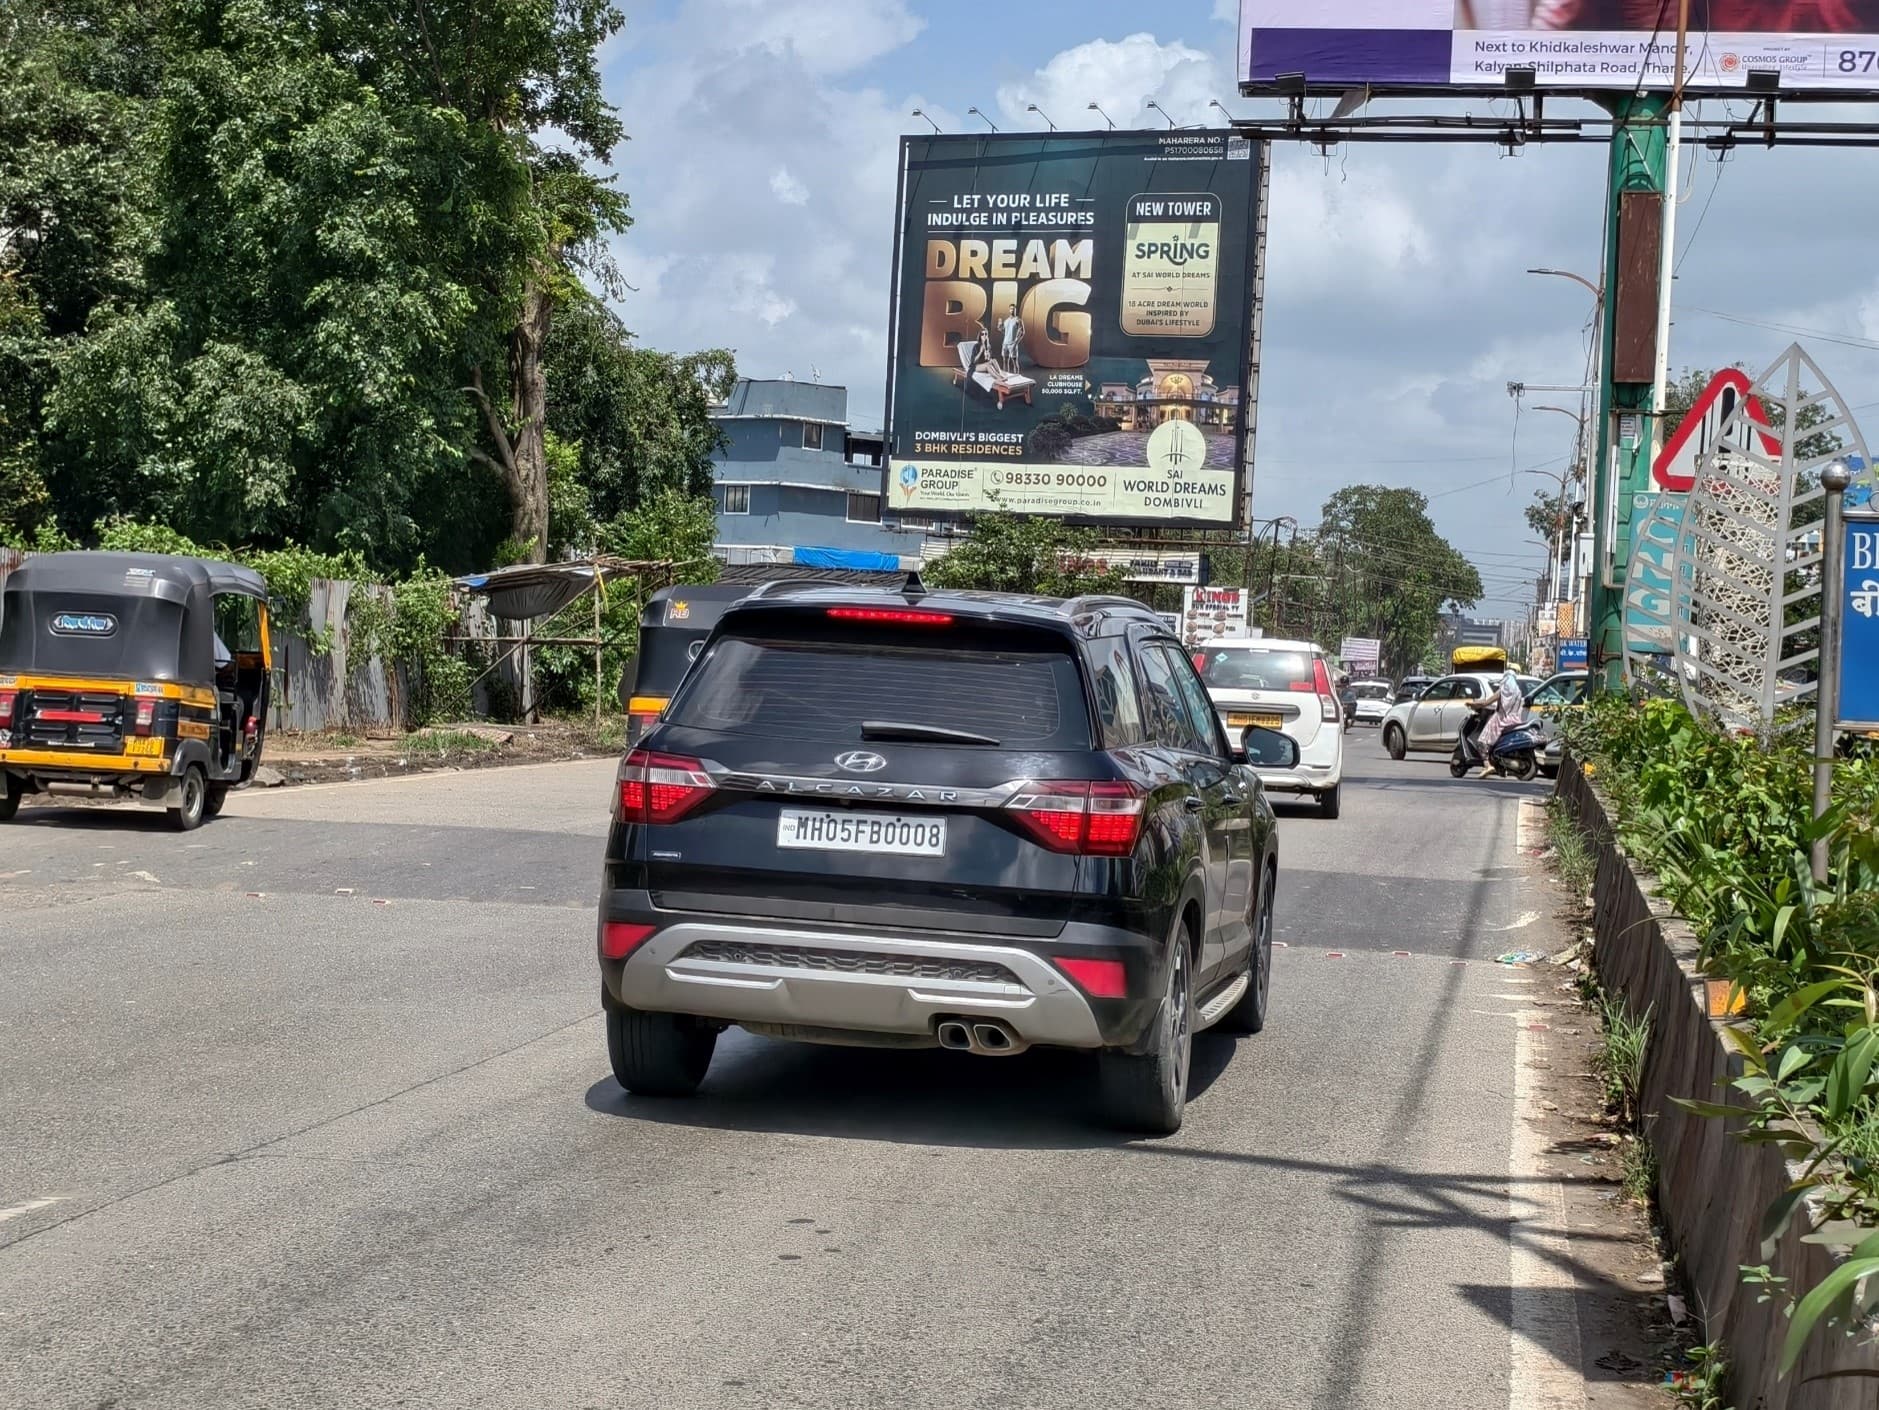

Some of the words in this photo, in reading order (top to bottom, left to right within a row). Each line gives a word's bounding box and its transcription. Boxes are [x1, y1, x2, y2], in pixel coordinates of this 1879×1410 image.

[1475, 41, 1507, 53] Next
[1511, 41, 1525, 53] to
[1529, 41, 1636, 54] Khidkaleshwar
[1639, 43, 1693, 56] Manr,
[1741, 55, 1777, 63] COSMOS
[1600, 62, 1641, 75] Road,
[1158, 136, 1205, 145] MAHARERA
[953, 194, 981, 208] LET
[986, 194, 1030, 208] YOUR
[1036, 193, 1070, 207] LIFE
[1135, 201, 1165, 216] NEW
[1167, 201, 1212, 216] TOWER
[927, 212, 989, 226] INDULGE
[992, 212, 1007, 225] IN
[1011, 211, 1095, 225] PLEASURES
[1135, 235, 1210, 266] SPRING
[925, 239, 1094, 279] DREAM
[1131, 271, 1141, 279] AT
[1142, 271, 1154, 279] SAI
[1155, 271, 1180, 279] WORLD
[1182, 271, 1210, 279] DREAMS
[1137, 300, 1155, 308] ACRE
[1157, 300, 1181, 308] DREAM
[919, 277, 1092, 369] BIG
[1164, 319, 1200, 327] LIFESTYLE
[914, 431, 976, 442] DOMBIVLI'S
[978, 432, 1025, 444] BIGGEST
[914, 443, 921, 453] 3
[924, 443, 949, 454] BHK
[951, 444, 1023, 456] RESIDENCES
[920, 467, 974, 479] PARADISE
[1005, 471, 1050, 486] 98330
[1056, 473, 1107, 488] 90000
[1166, 469, 1183, 480] SAI
[920, 479, 959, 490] GROUP
[1123, 479, 1170, 494] WORLD
[1173, 481, 1226, 497] DREAMS
[994, 494, 1102, 507] www.paradisegroup.co.in
[1144, 496, 1203, 509] DOMBIVLI
[755, 779, 959, 802] ALCAZAR
[796, 814, 941, 849] MH05FB0008
